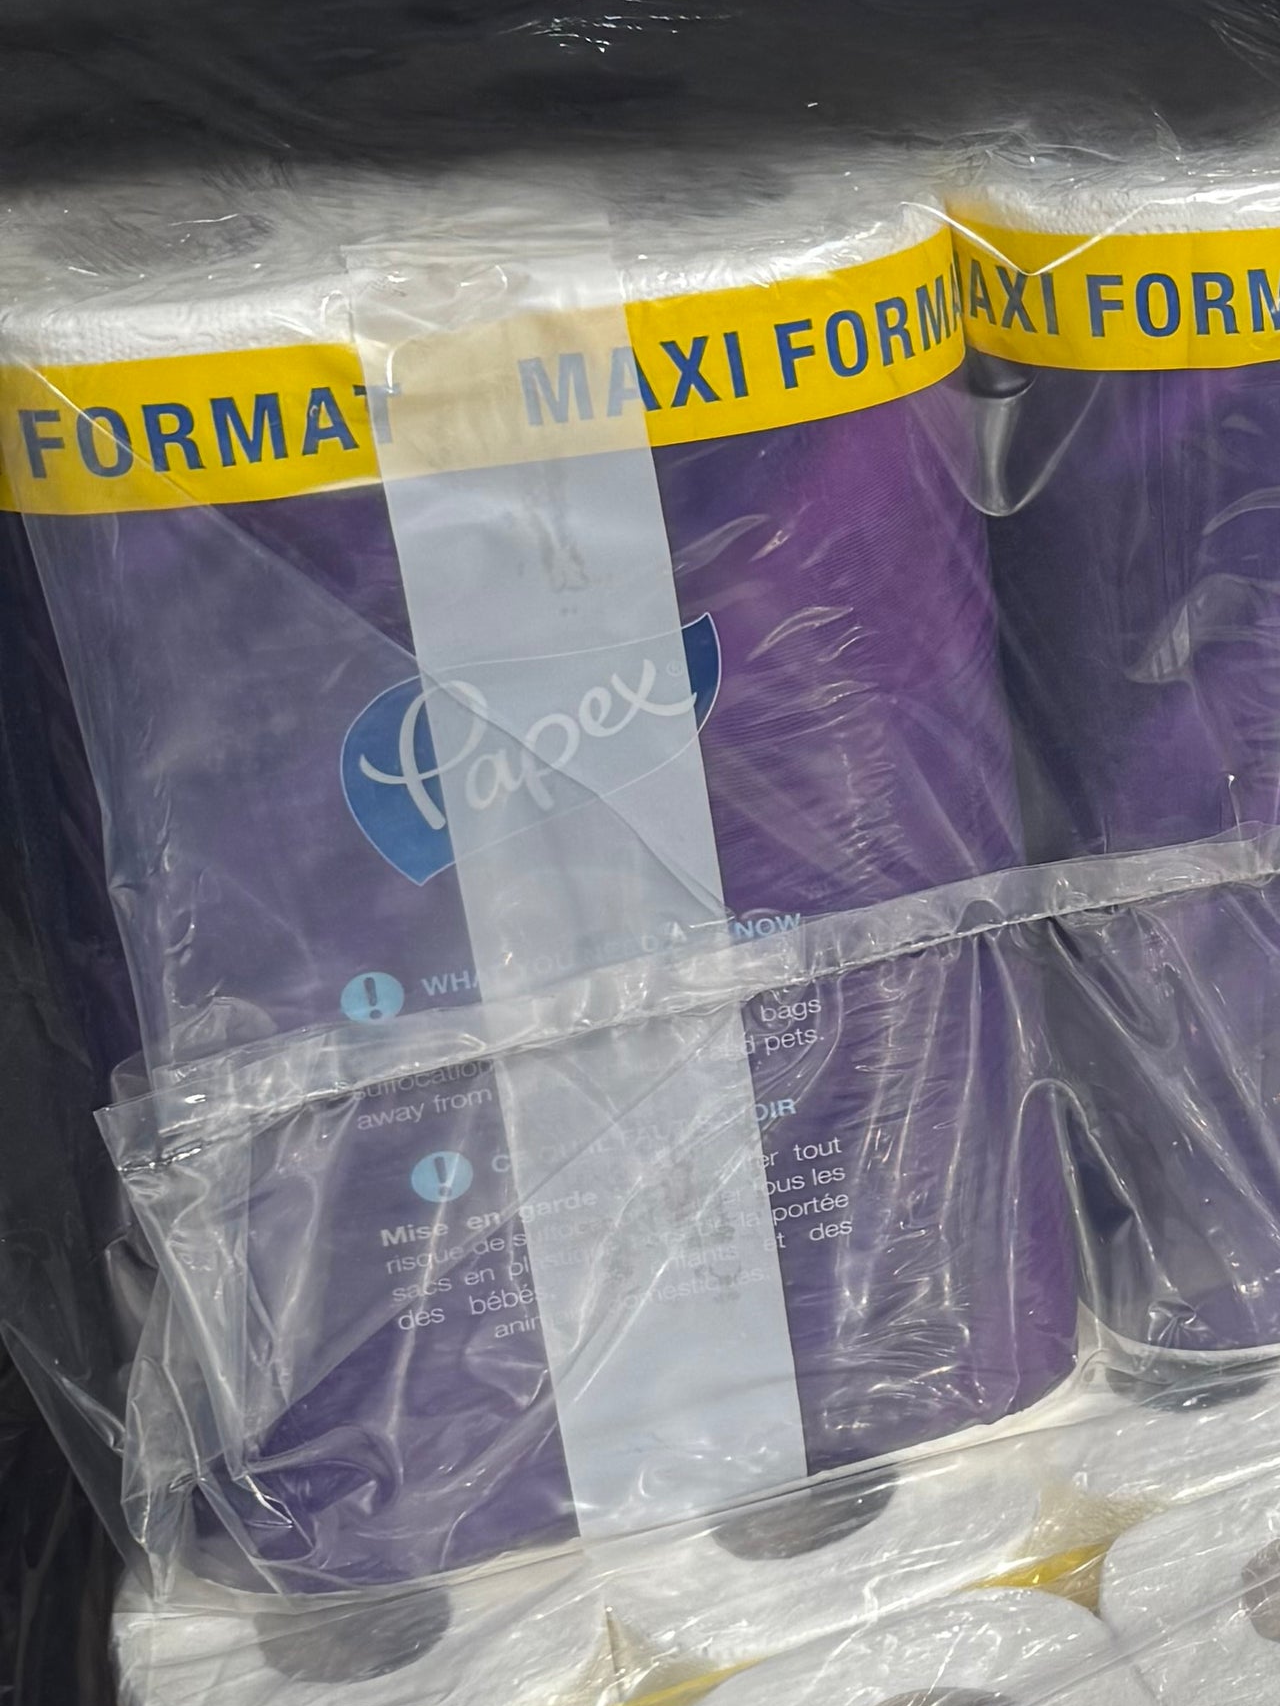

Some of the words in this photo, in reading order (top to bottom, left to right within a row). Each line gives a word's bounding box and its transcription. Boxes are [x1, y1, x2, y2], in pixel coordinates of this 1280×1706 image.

[17, 381, 402, 479] FORMAT
[518, 327, 750, 429] MAXI
[358, 657, 698, 833] Papex
[733, 912, 803, 941] NOW
[759, 995, 823, 1025] bags
[356, 1099, 427, 1132] away
[433, 1085, 493, 1118] from
[764, 1029, 826, 1062] pets.
[380, 1219, 449, 1248] Mise
[466, 1209, 500, 1230] en
[518, 1188, 598, 1225] garde
[792, 1137, 843, 1161] tout
[386, 1247, 470, 1276] risque
[473, 1232, 506, 1256] de
[810, 1165, 847, 1188] les
[391, 1276, 453, 1303] sacs
[463, 1265, 496, 1287] en
[771, 1191, 850, 1229] portée
[397, 1307, 445, 1331] des
[809, 1218, 854, 1242] des
